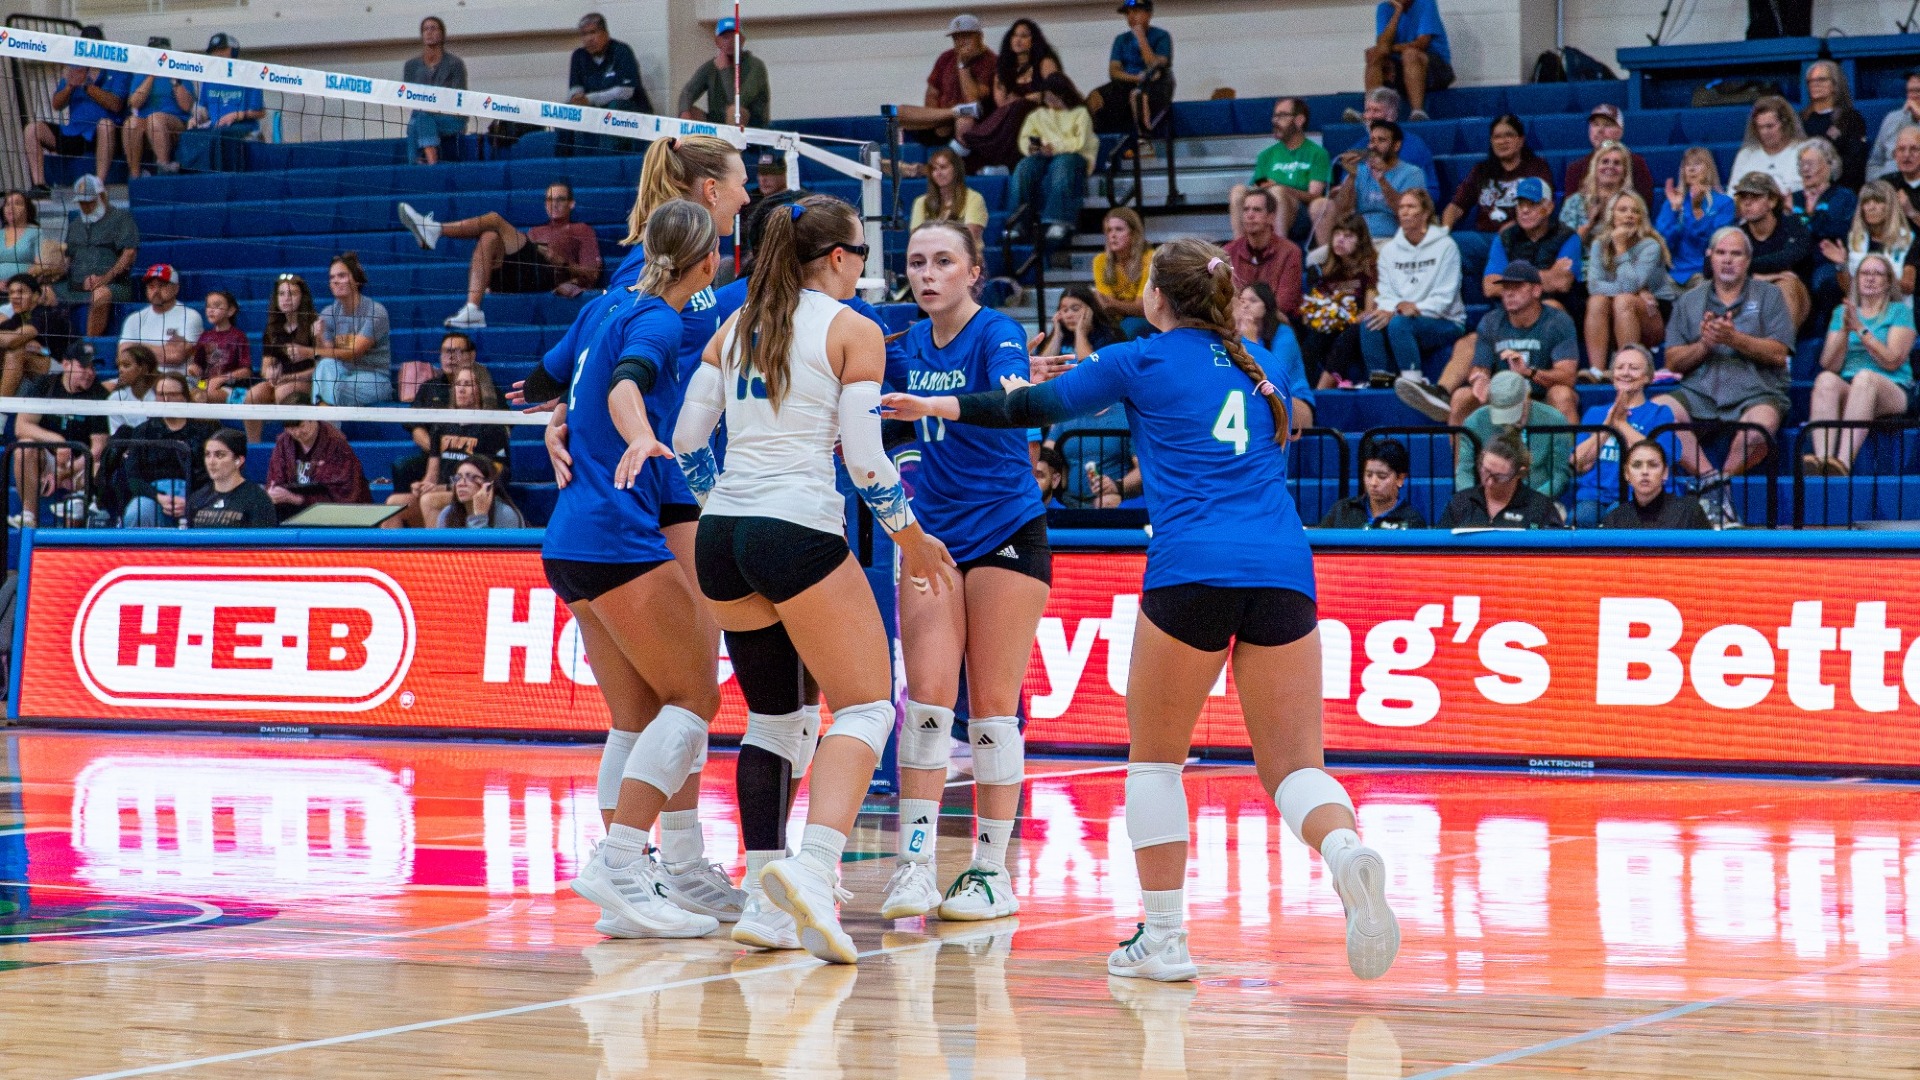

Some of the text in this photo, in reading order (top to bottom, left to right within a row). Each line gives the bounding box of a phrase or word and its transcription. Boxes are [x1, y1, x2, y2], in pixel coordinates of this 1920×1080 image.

[8, 36, 47, 53] Domino's
[74, 40, 129, 63] ISLANDERS
[168, 58, 204, 74] Domino's
[269, 72, 302, 86] Domino's
[325, 74, 372, 95] ISLANDERS
[406, 89, 437, 103] Domino's
[491, 101, 521, 114] Domino's
[540, 103, 583, 123] ISLANDERS
[611, 116, 639, 129] Domino's
[1213, 391, 1249, 456] 4
[1528, 759, 1594, 768] DAKTRONICS
